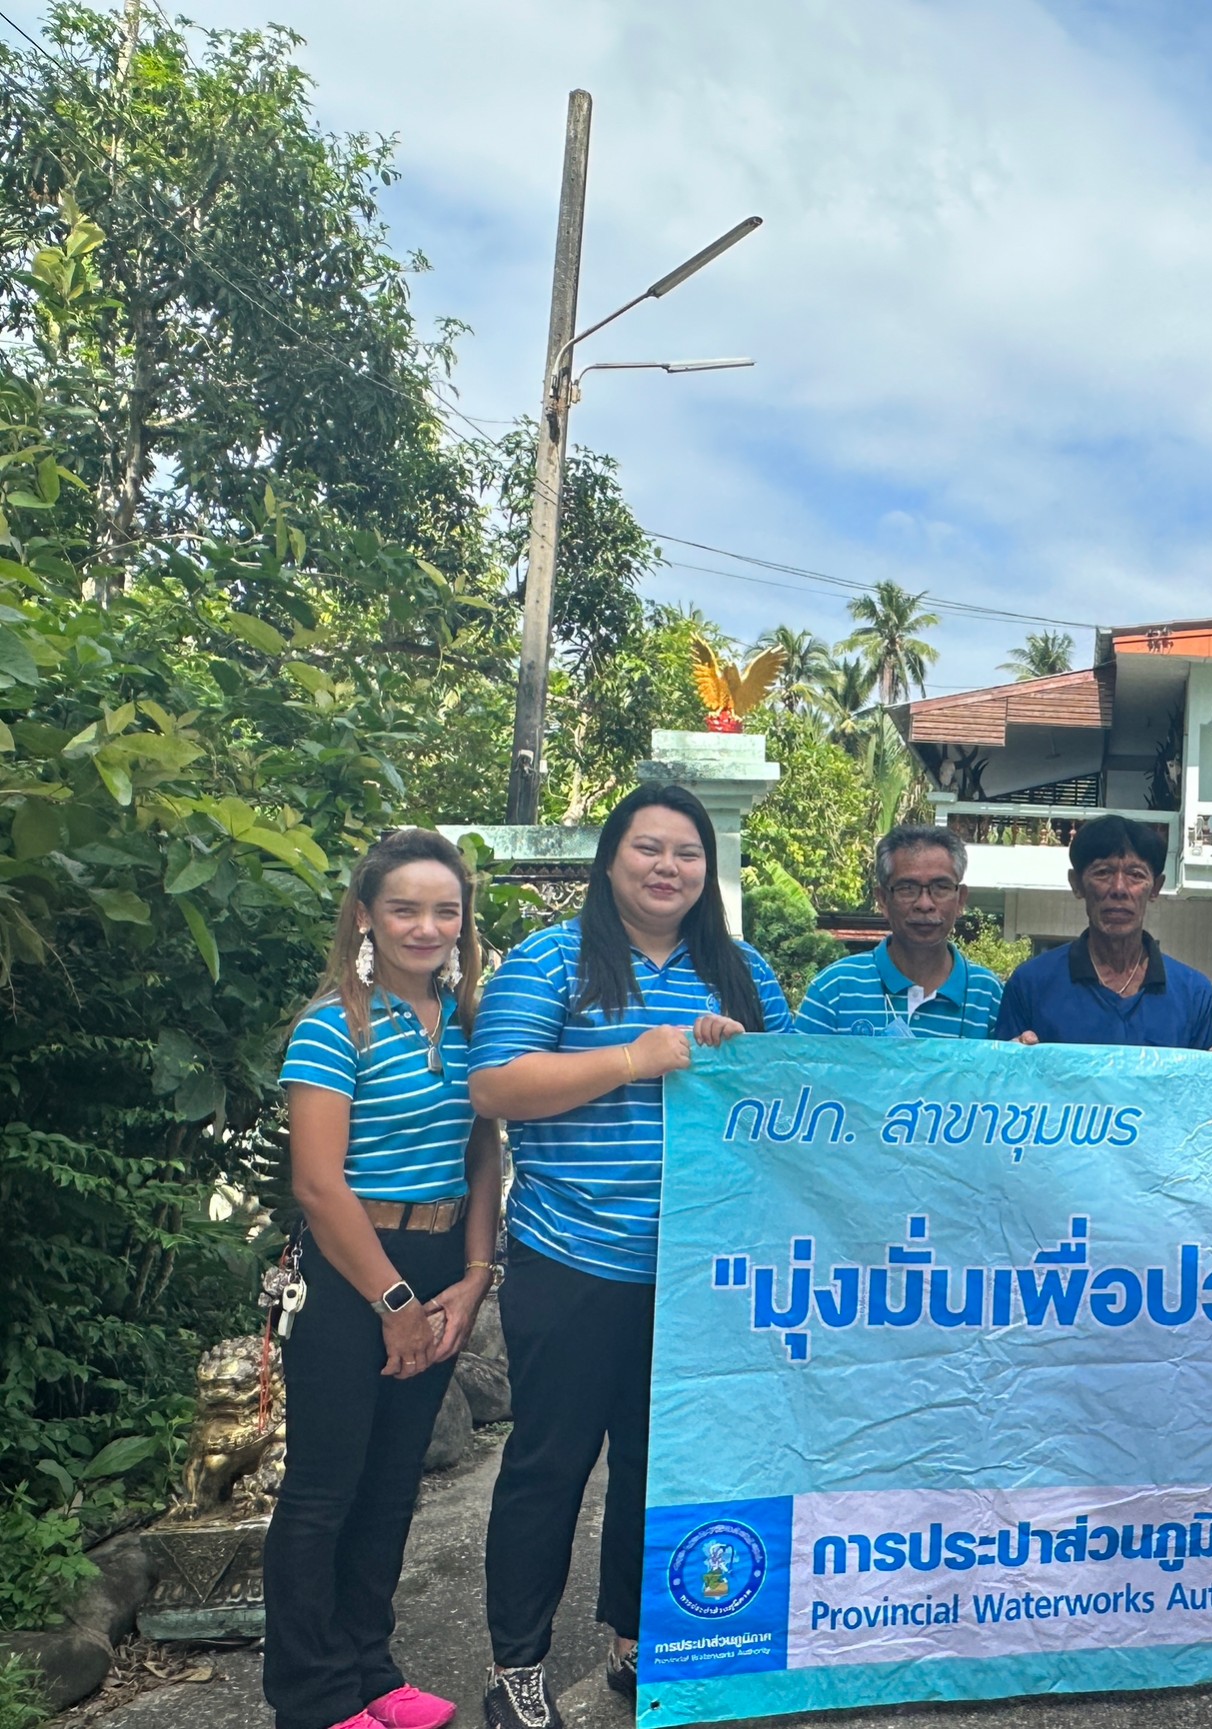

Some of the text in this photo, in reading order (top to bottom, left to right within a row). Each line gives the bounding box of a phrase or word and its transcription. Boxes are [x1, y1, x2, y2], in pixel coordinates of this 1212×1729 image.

[724, 1085, 1142, 1163] กปภ. สาขาชุมพร
[811, 1594, 959, 1630] Provincial
[973, 1582, 1155, 1624] Waterworks
